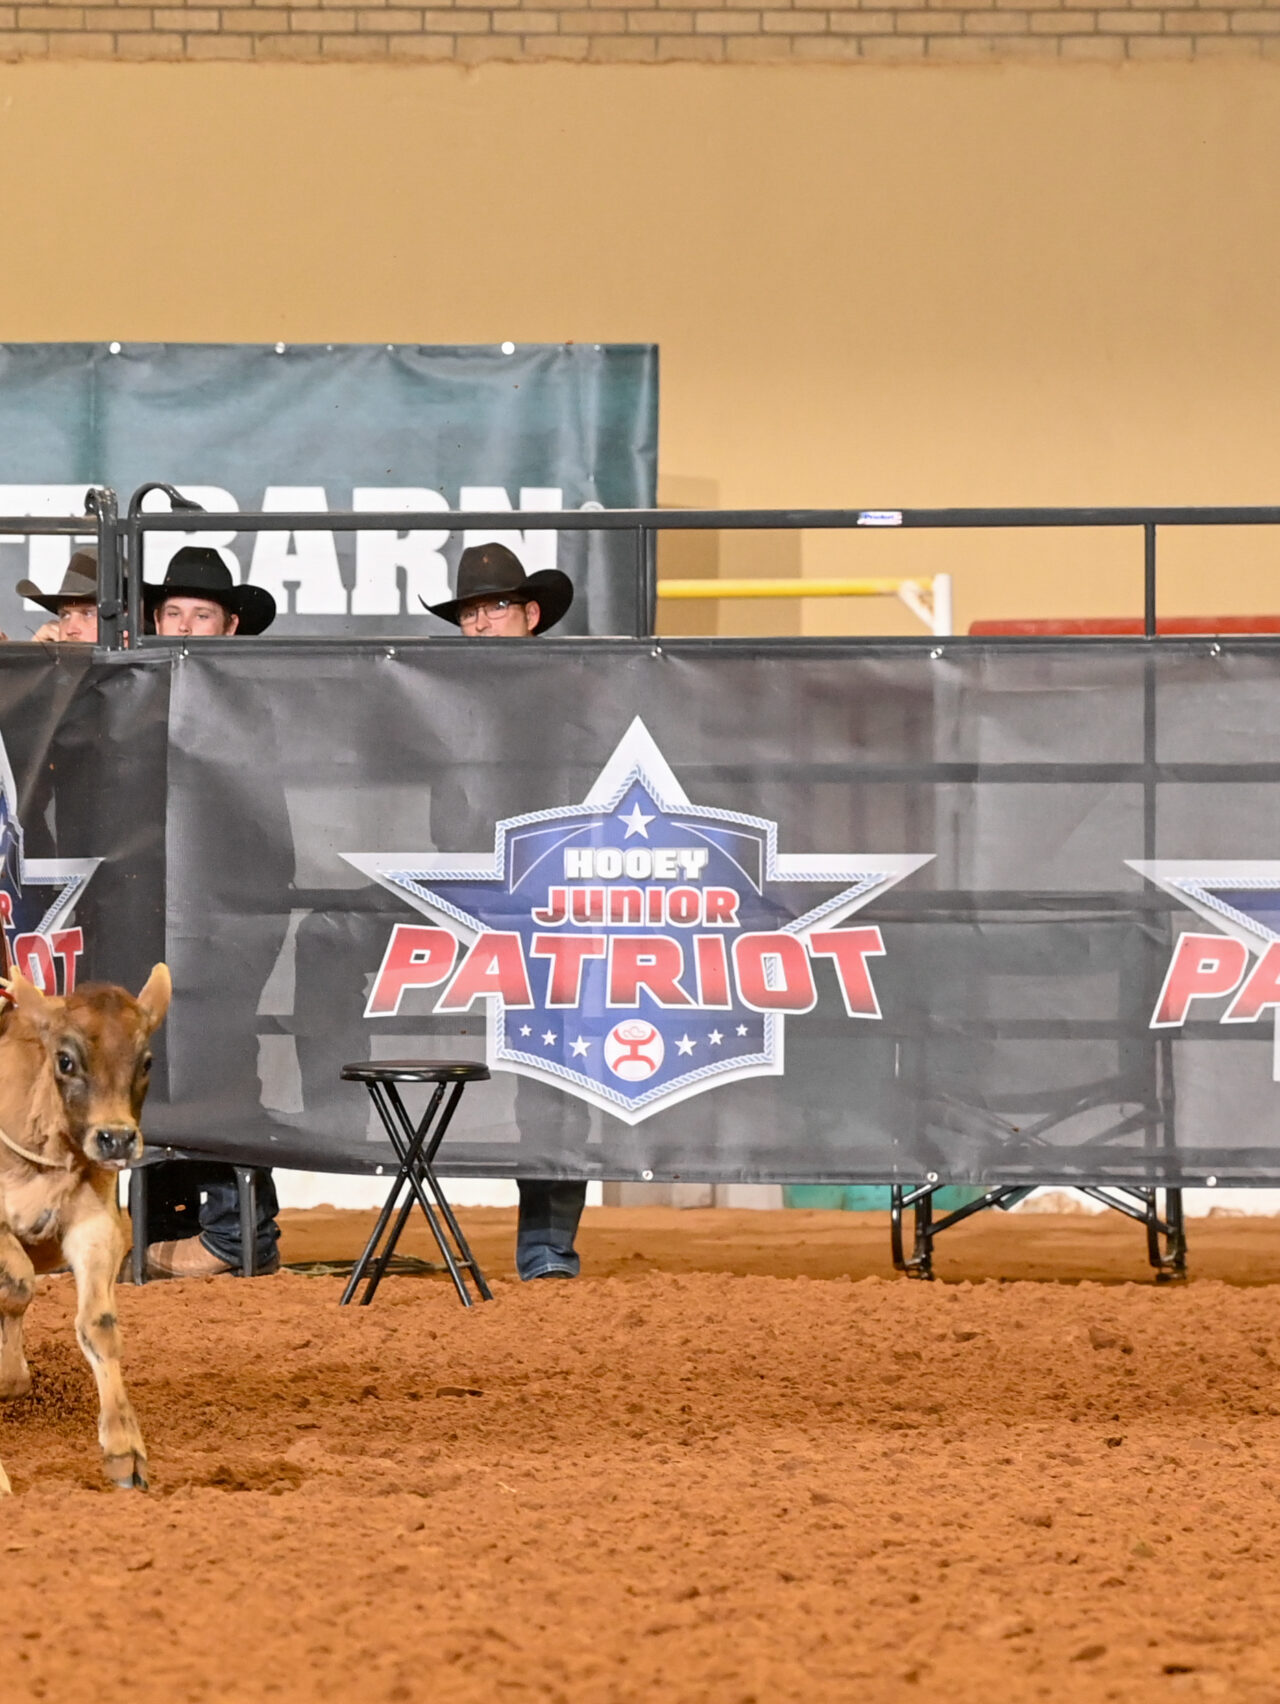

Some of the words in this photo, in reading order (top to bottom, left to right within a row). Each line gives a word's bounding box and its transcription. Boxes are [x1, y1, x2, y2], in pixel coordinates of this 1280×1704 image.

[564, 847, 710, 882] HOOEY
[532, 886, 741, 928] JUNIOR
[363, 923, 888, 1020] PATRIOT
